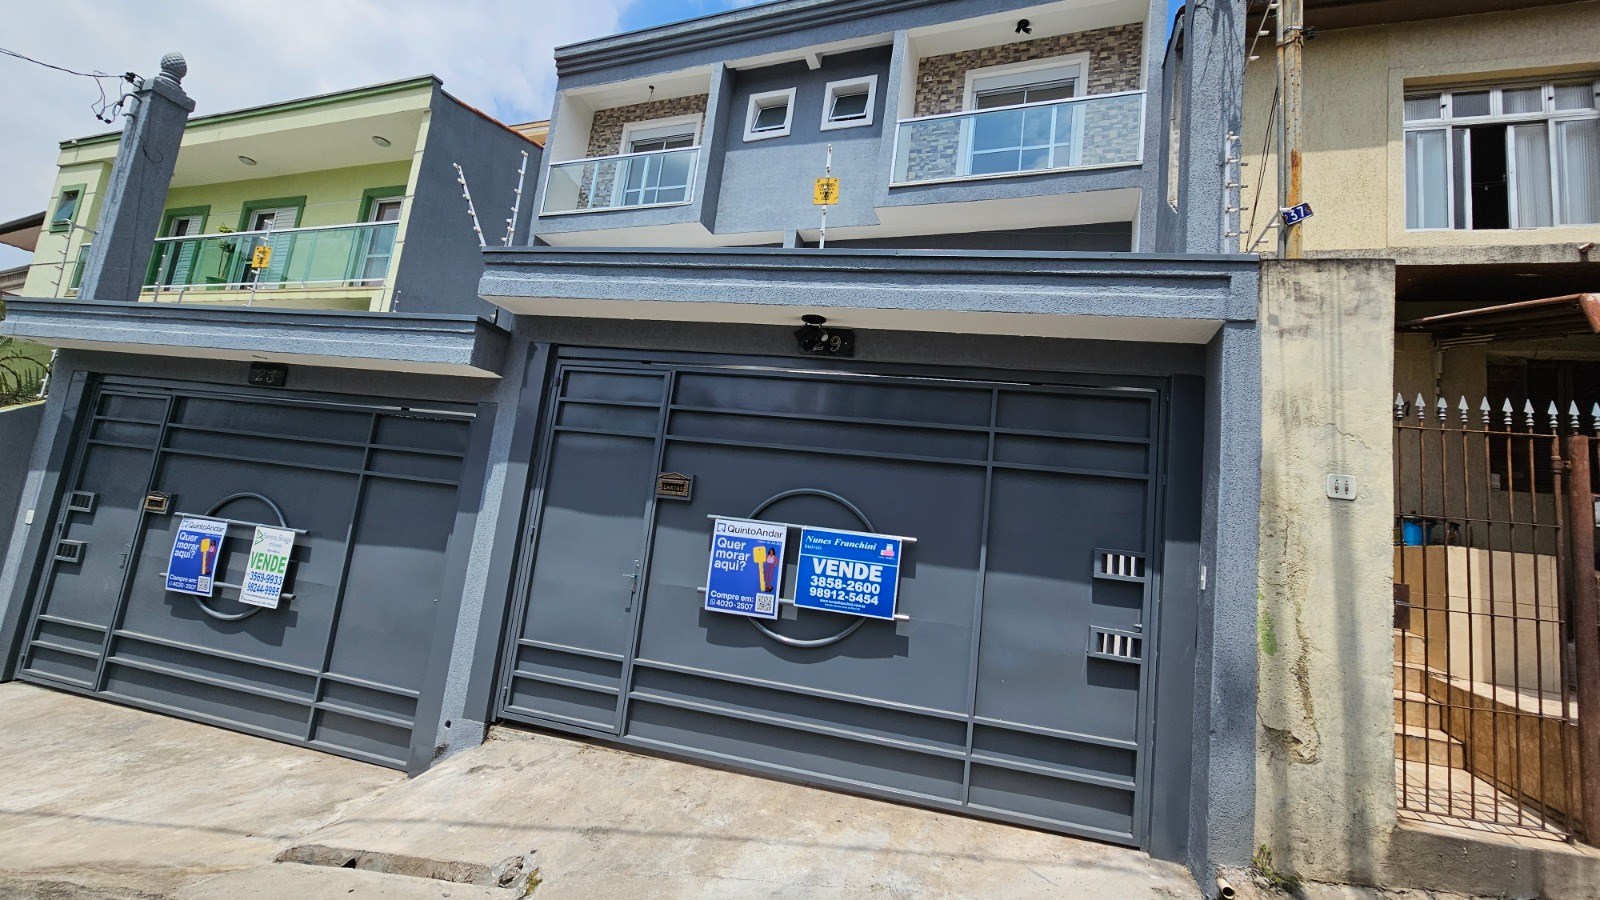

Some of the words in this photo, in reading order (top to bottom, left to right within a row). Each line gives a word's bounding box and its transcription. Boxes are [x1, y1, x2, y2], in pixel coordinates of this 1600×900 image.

[1291, 206, 1304, 220] 37
[189, 521, 225, 532] QuintoAndar
[727, 525, 783, 538] QuintoAndar
[179, 532, 198, 542] Quer
[717, 537, 746, 550] Quer
[805, 535, 832, 545] Nunes
[834, 538, 877, 551] Franchini
[177, 541, 199, 551] morar
[174, 549, 196, 559] aqui?
[715, 549, 750, 561] morar
[250, 551, 287, 574] VENDE
[714, 559, 746, 572] aqui?
[812, 557, 883, 582] VENDE
[250, 571, 283, 586] 3569-9933
[810, 575, 880, 594] 3858-2600
[710, 590, 739, 600] Compre
[741, 595, 754, 603] em:
[809, 586, 879, 606] 98912-5454
